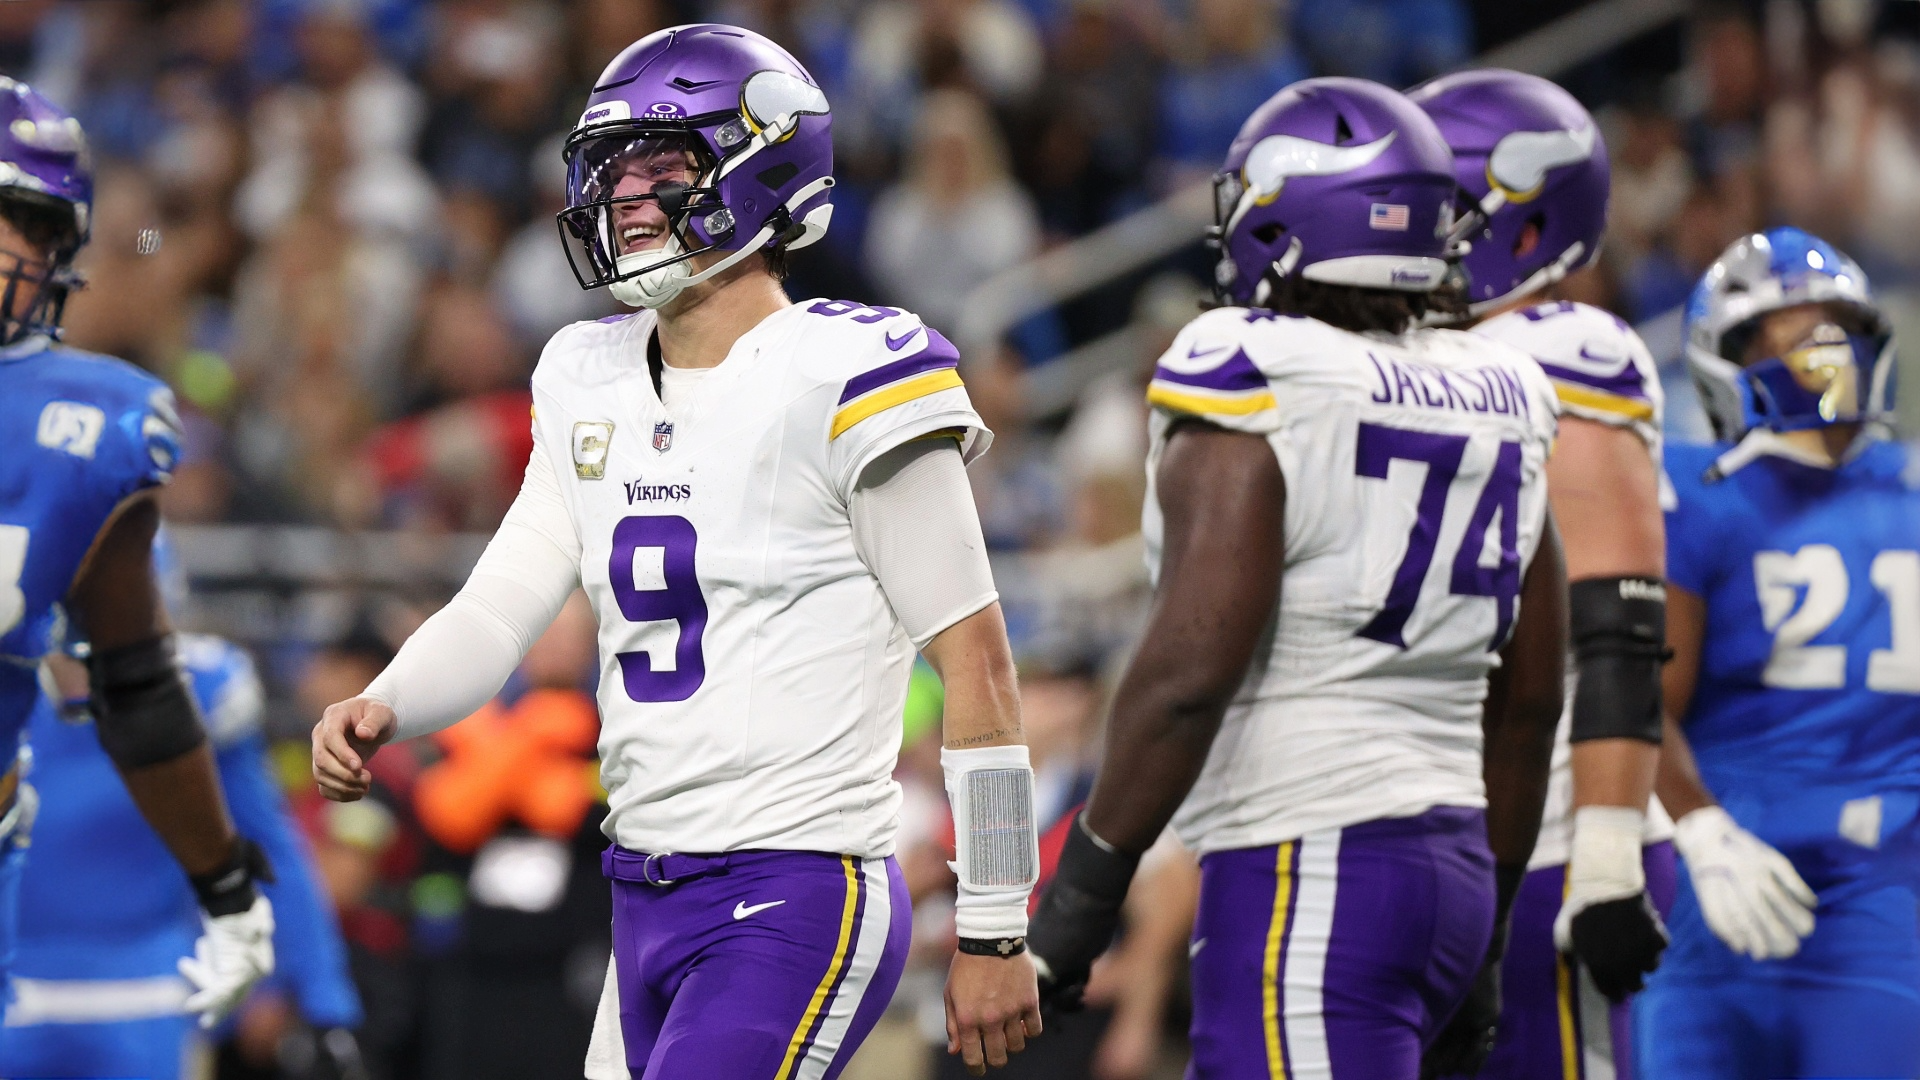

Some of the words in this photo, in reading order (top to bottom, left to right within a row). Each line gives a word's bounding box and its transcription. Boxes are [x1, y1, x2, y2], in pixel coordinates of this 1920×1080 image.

[644, 112, 686, 120] OAKLEY
[806, 299, 901, 324] 9
[1368, 350, 1531, 421] JACKSON
[573, 422, 611, 467] C
[653, 433, 669, 448] NFL
[1355, 420, 1523, 653] 74
[608, 515, 709, 703] 9
[1753, 543, 1920, 694] 21
